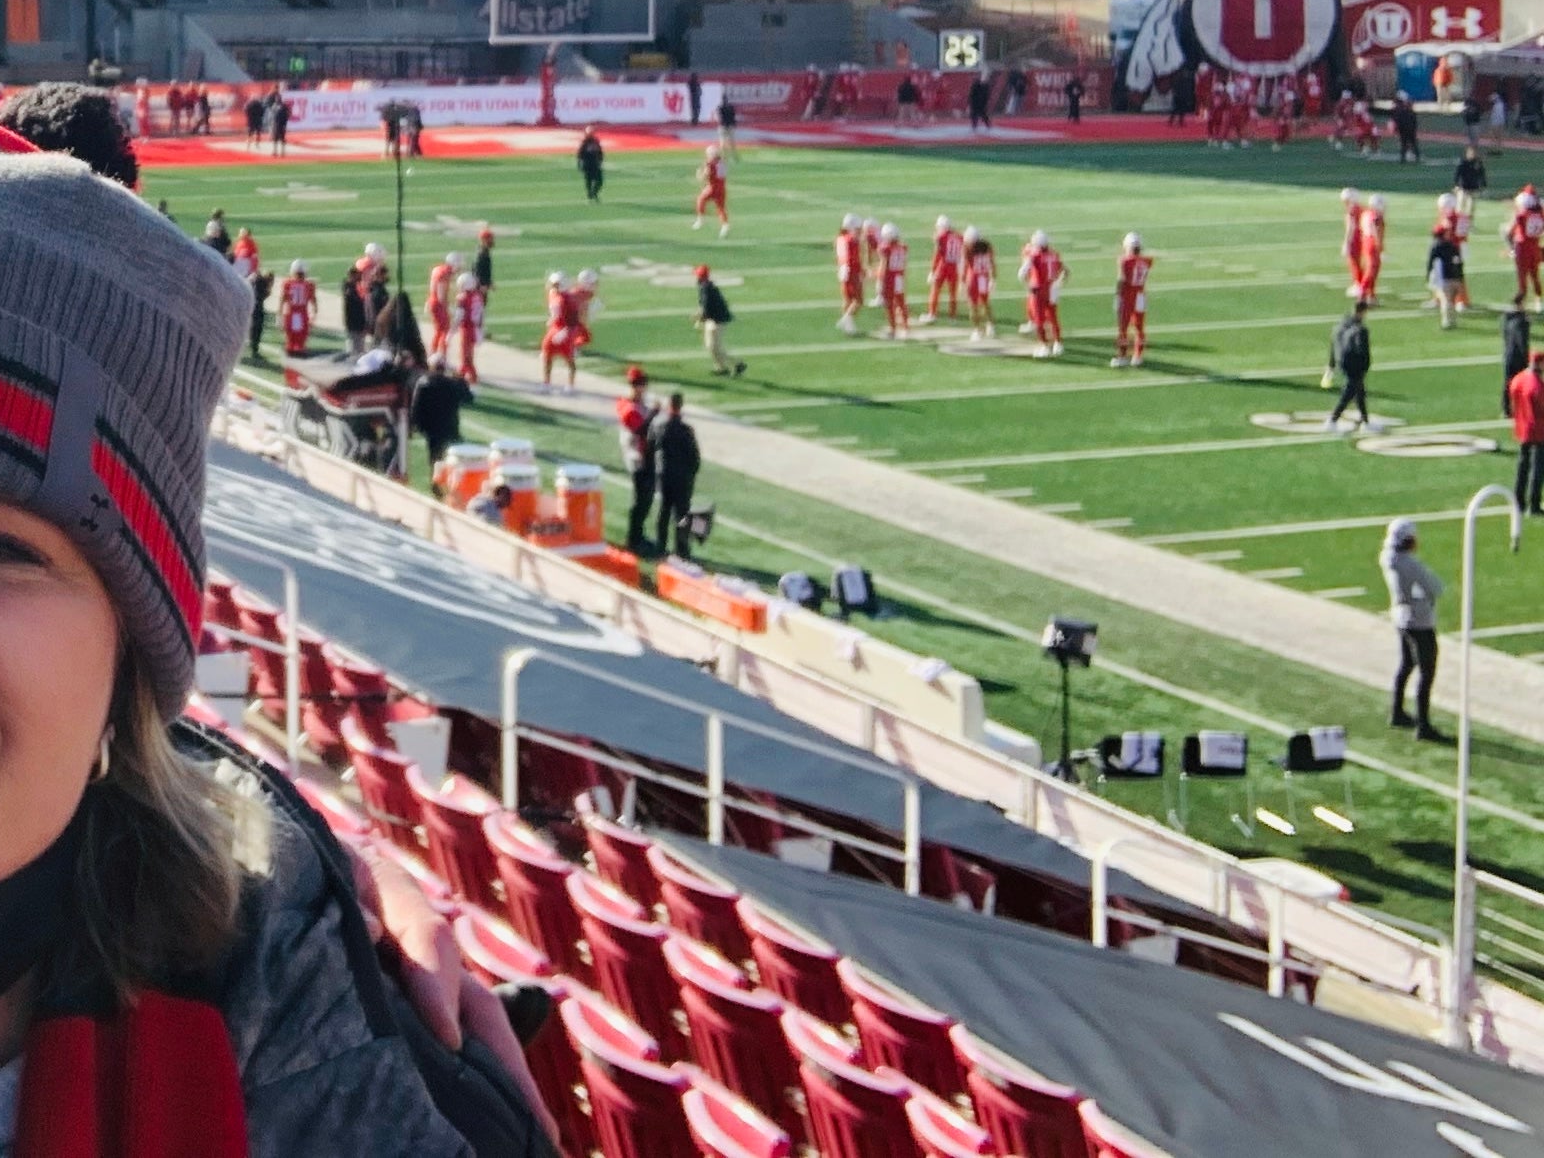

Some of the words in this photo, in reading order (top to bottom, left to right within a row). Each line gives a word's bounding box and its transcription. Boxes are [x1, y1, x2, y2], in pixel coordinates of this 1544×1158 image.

[1377, 12, 1402, 39] U
[312, 98, 367, 115] HEALTH
[430, 98, 455, 111] FOR
[462, 98, 482, 111] THE
[485, 98, 519, 111] UTAH
[574, 97, 601, 110] AND
[606, 96, 645, 109] YOURS
